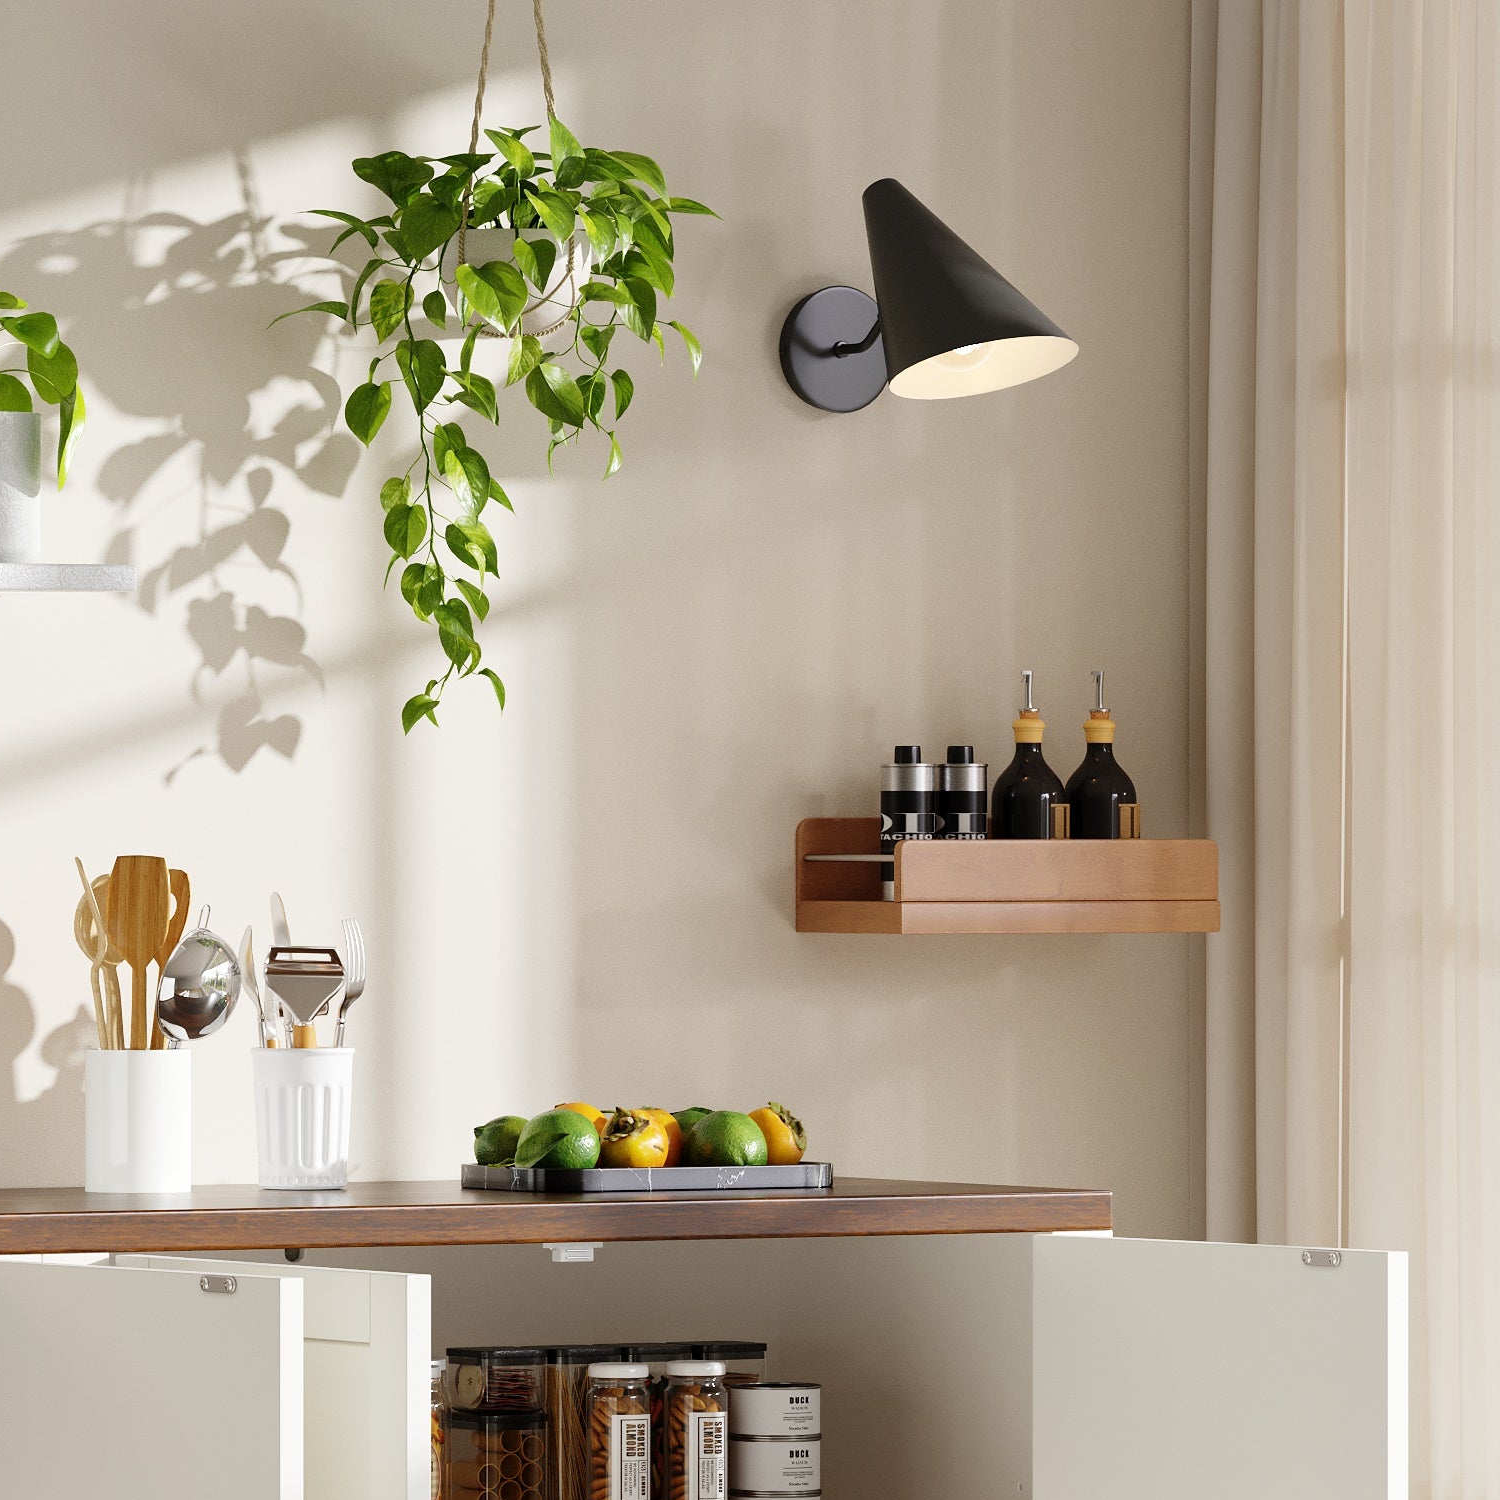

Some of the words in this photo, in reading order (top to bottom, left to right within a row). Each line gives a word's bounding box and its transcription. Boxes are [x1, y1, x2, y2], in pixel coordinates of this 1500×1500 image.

[789, 1396, 809, 1404] DUCK
[626, 1424, 636, 1456] ALMOND
[637, 1423, 646, 1456] SMOKED
[704, 1422, 714, 1454] ALMOND
[714, 1422, 722, 1454] SMOKED
[789, 1450, 809, 1458] DUCK
